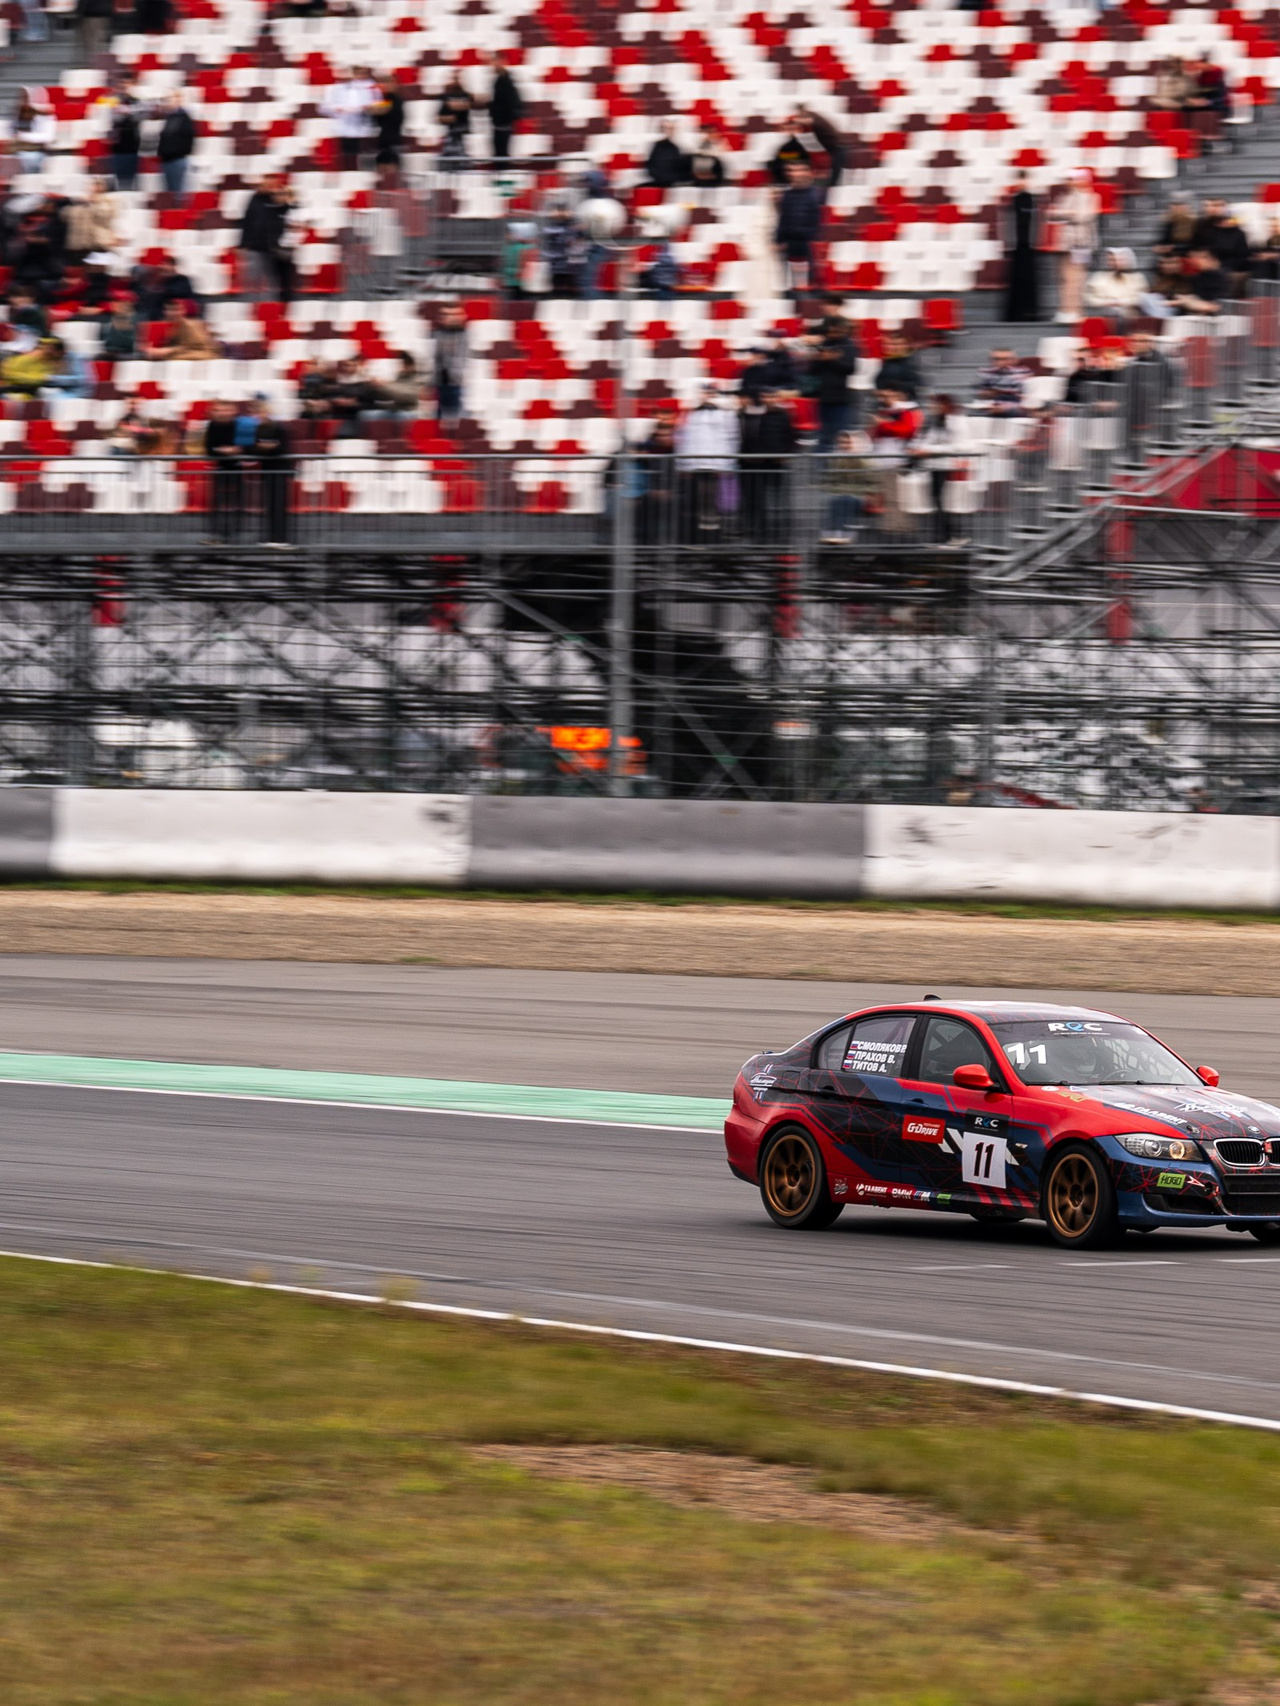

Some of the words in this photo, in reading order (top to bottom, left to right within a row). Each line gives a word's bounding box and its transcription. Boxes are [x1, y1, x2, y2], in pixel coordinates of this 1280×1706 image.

[857, 1040, 901, 1053] СМОЛЯКОВ
[1007, 1042, 1047, 1064] 11
[854, 1051, 887, 1063] ПРАХОВ
[852, 1061, 879, 1072] ТИТОВ
[973, 1142, 995, 1179] 11
